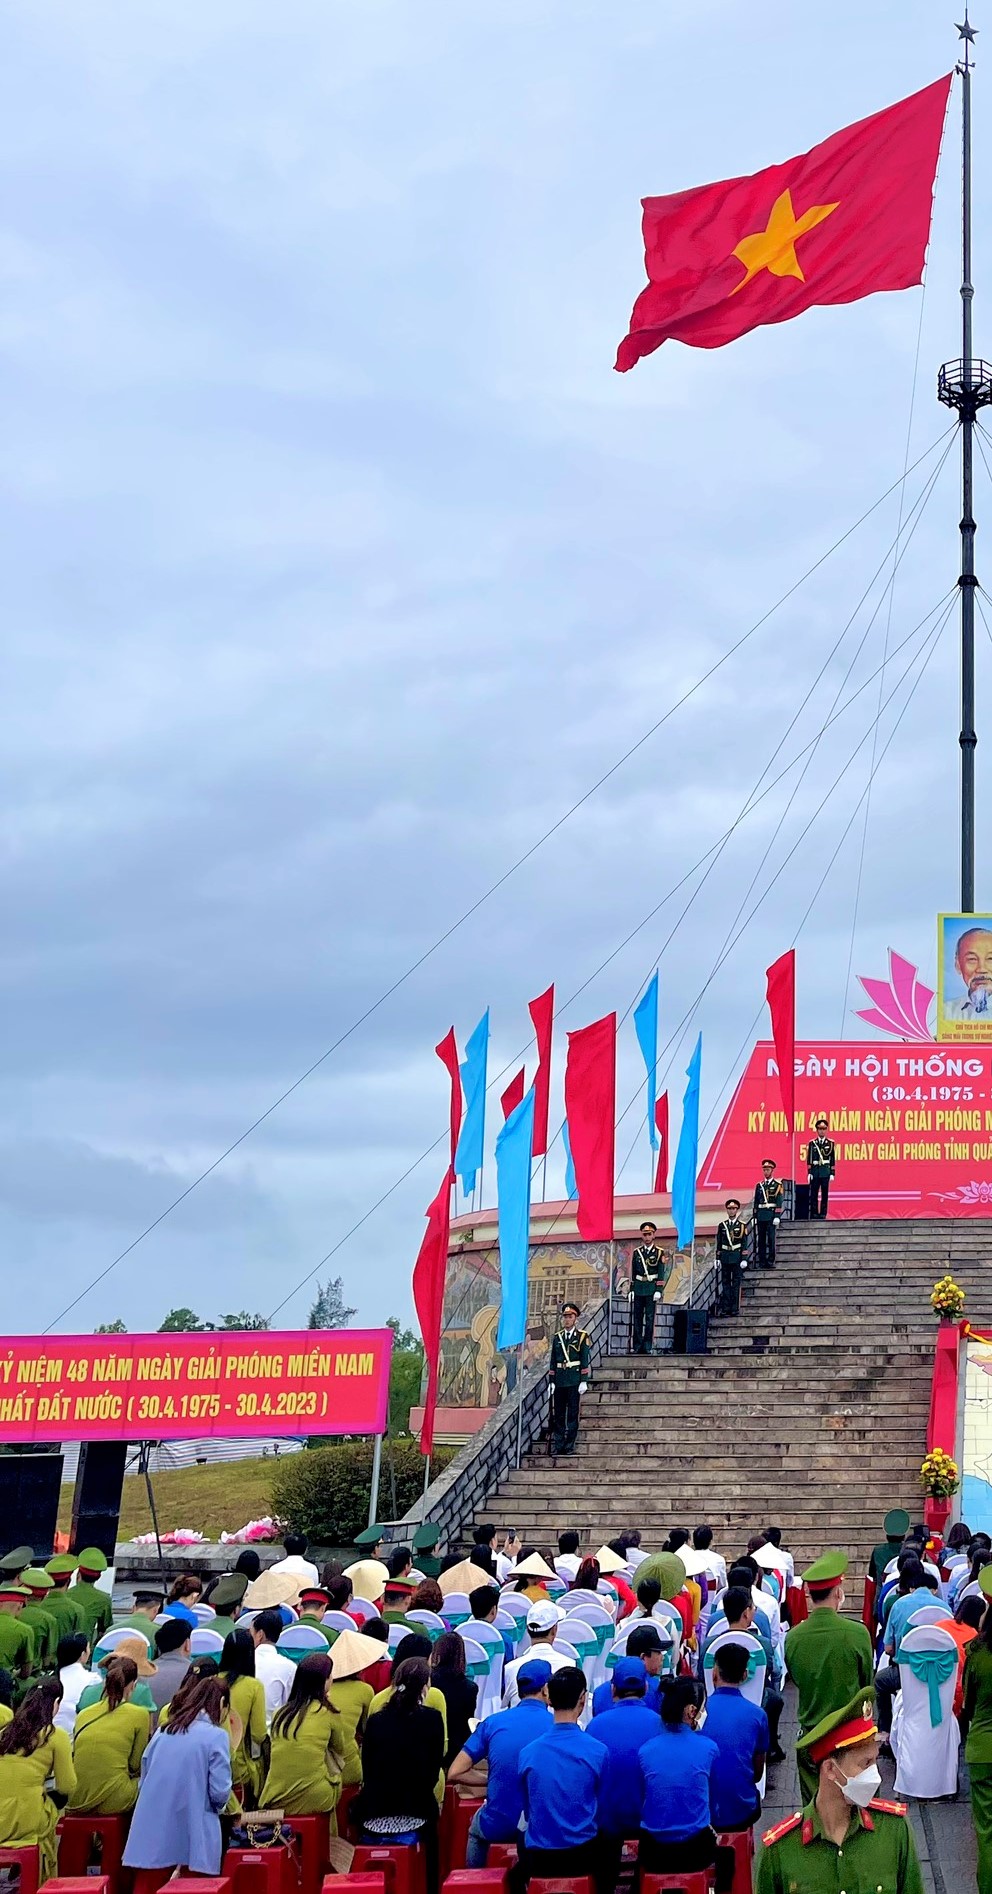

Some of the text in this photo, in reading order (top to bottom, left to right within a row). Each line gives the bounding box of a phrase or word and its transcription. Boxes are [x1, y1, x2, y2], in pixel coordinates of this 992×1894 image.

[845, 1054, 888, 1082] HỘI
[896, 1052, 984, 1077] THỐNG
[748, 1102, 766, 1132] KỶ
[769, 1110, 805, 1136] NIM
[830, 1106, 860, 1132] NĂM
[865, 1106, 901, 1132] NGÀY
[905, 1102, 931, 1131] GIẢI
[935, 1106, 981, 1132] PHÓNG
[844, 1138, 874, 1161] NGÀY
[878, 1136, 900, 1161] GIẢI
[903, 1139, 941, 1161] PHÓNG
[944, 1136, 968, 1161] TỈNH
[0, 1346, 374, 1388] Ỷ NIỆM 48 NĂM NGÀY GIẢI PHÓNG MIỀN NAM
[0, 1389, 34, 1421] HẤT
[37, 1389, 71, 1421] ĐẤT
[74, 1389, 122, 1421] NƯỚC
